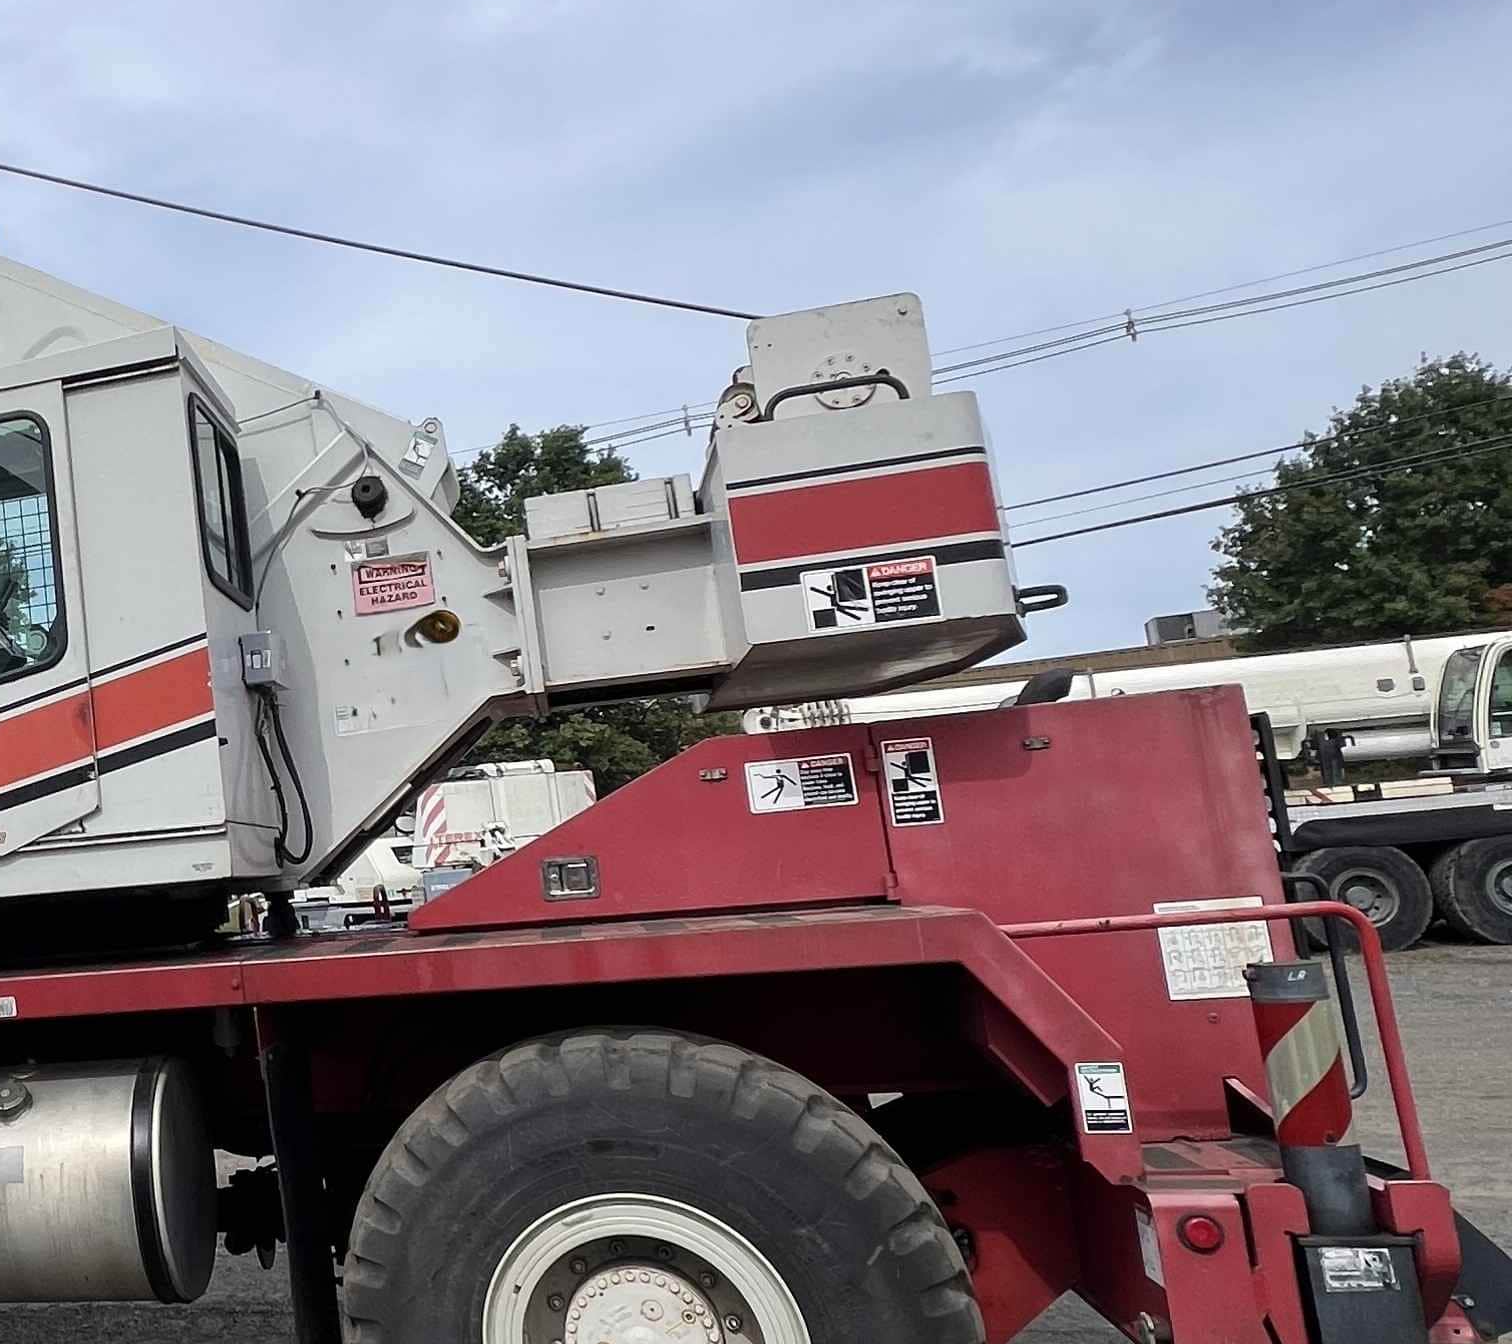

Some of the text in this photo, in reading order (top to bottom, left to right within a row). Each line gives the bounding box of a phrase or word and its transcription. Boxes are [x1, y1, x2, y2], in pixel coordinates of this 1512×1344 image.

[364, 564, 419, 579] WARNING
[879, 561, 928, 576] DANGER
[359, 579, 428, 596] ELECTRICAL
[371, 592, 418, 605] HAZARD
[810, 758, 844, 768] DANGER
[435, 831, 482, 843] TEREX
